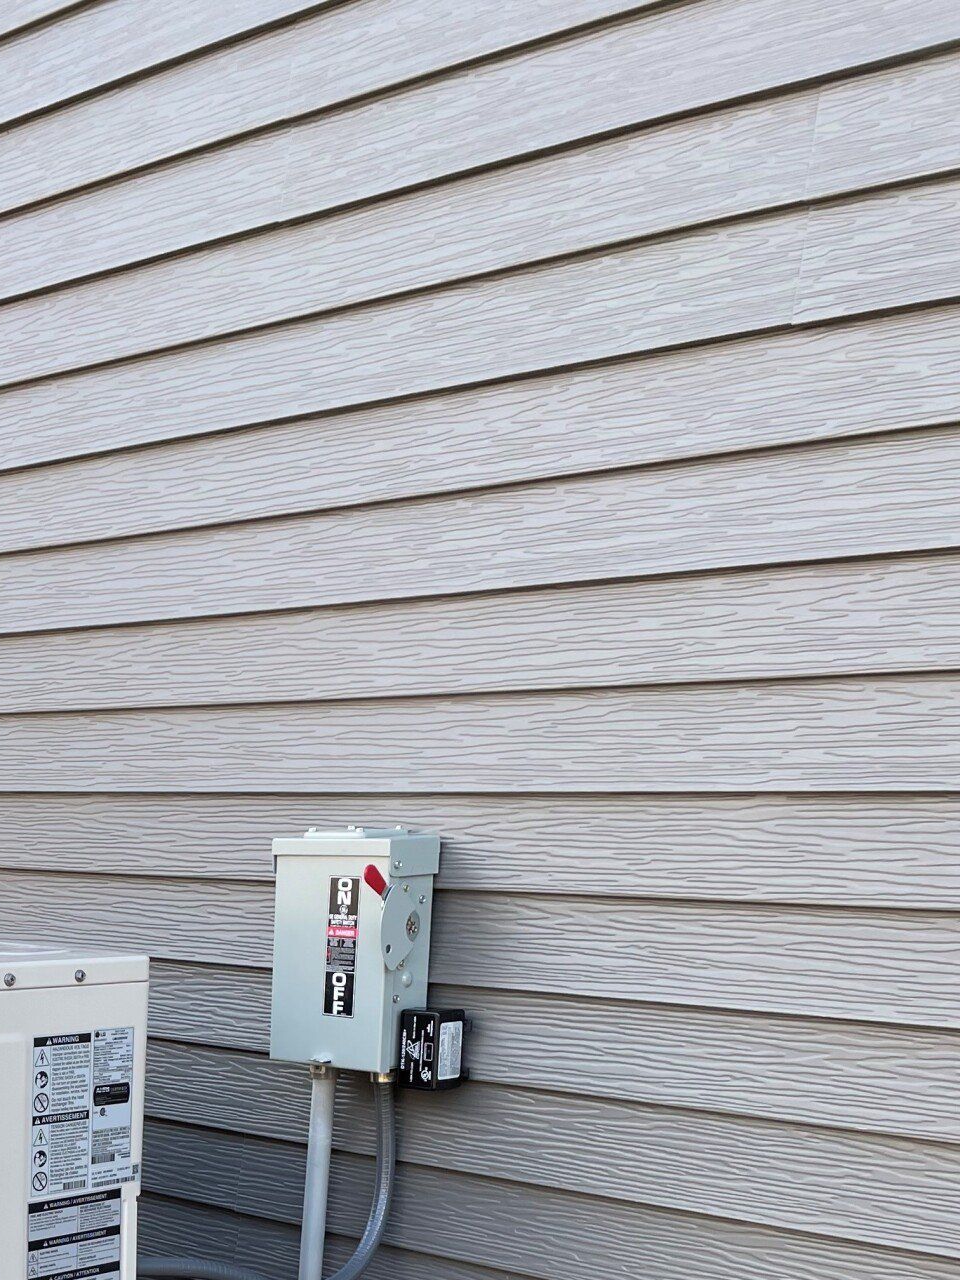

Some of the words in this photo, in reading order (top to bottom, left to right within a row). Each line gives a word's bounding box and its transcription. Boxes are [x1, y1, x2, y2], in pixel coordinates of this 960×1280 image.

[337, 878, 352, 905] ON
[331, 972, 347, 1014] OFF
[52, 1036, 79, 1044] WARNING
[41, 1112, 88, 1123] AVERTISSEMENT
[54, 1273, 74, 1280] CAUTION
[76, 1268, 100, 1277] ATTENTION
